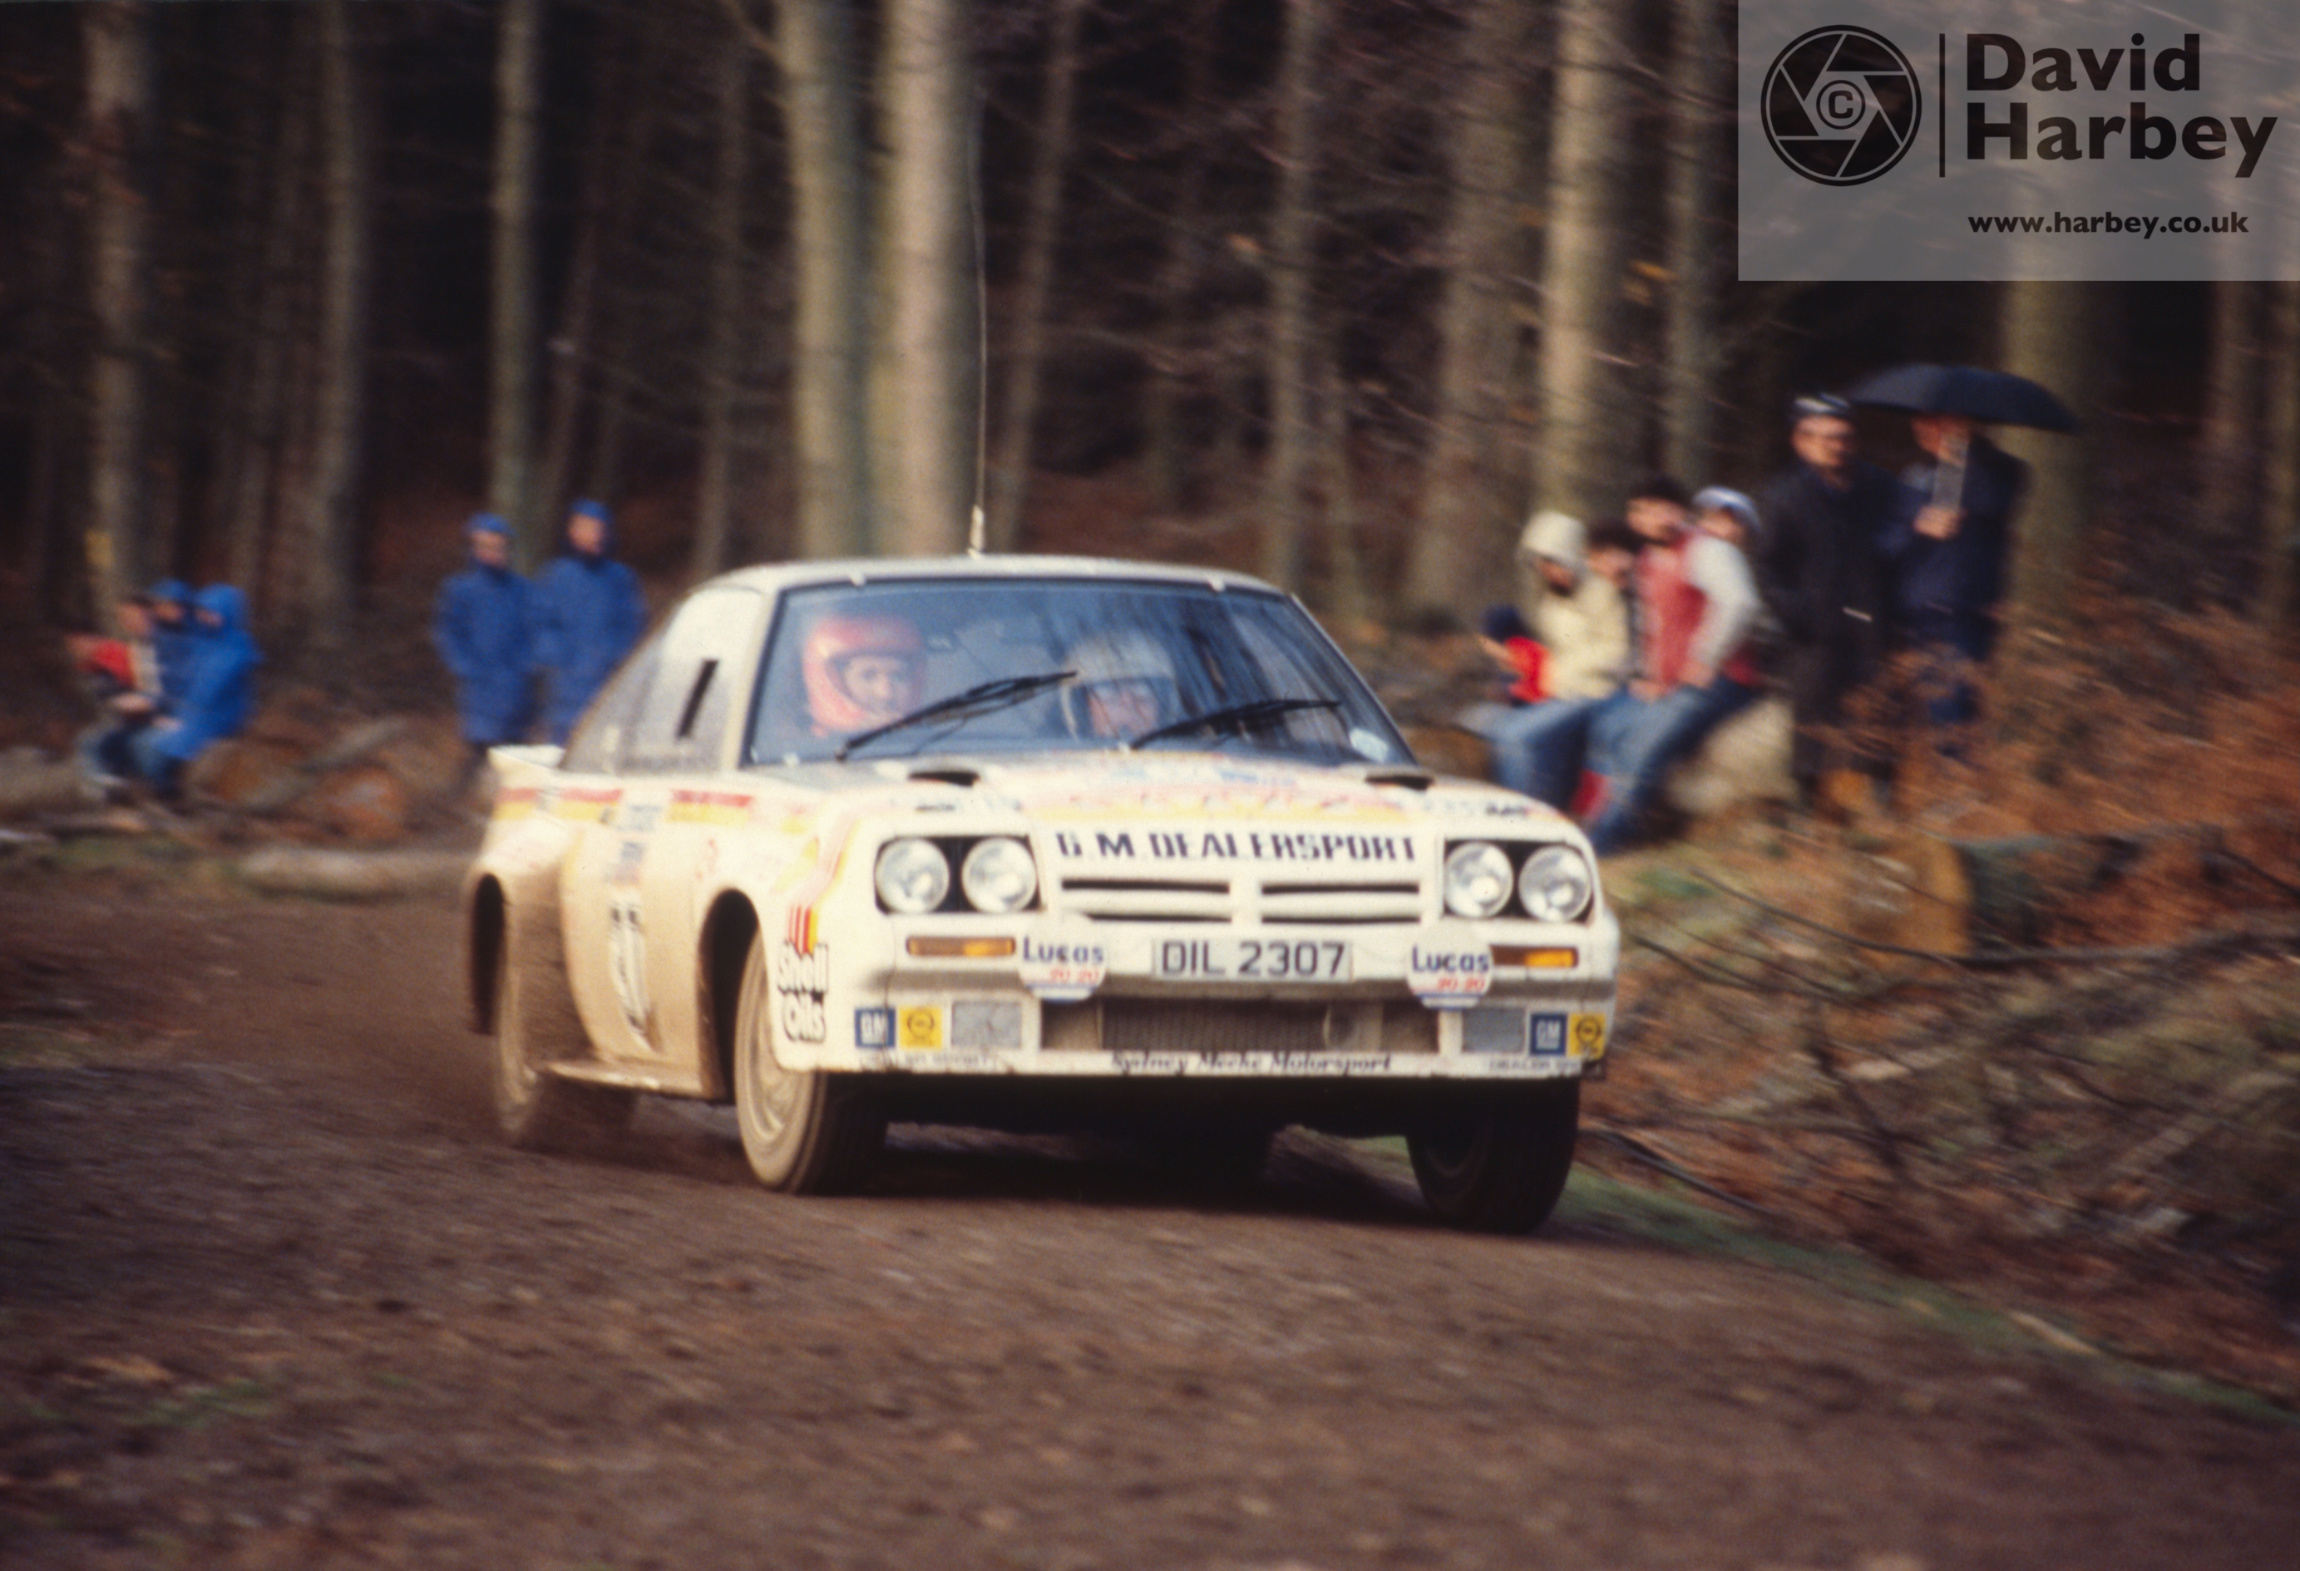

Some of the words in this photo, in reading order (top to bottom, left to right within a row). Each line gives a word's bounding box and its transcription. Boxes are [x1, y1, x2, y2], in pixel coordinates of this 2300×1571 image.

[1095, 832, 1136, 858] M
[777, 938, 829, 995] Shell
[1022, 935, 1105, 964] Lucas
[1238, 939, 1346, 978] 2307
[1411, 944, 1490, 972] Lucas
[782, 994, 827, 1043] Oils
